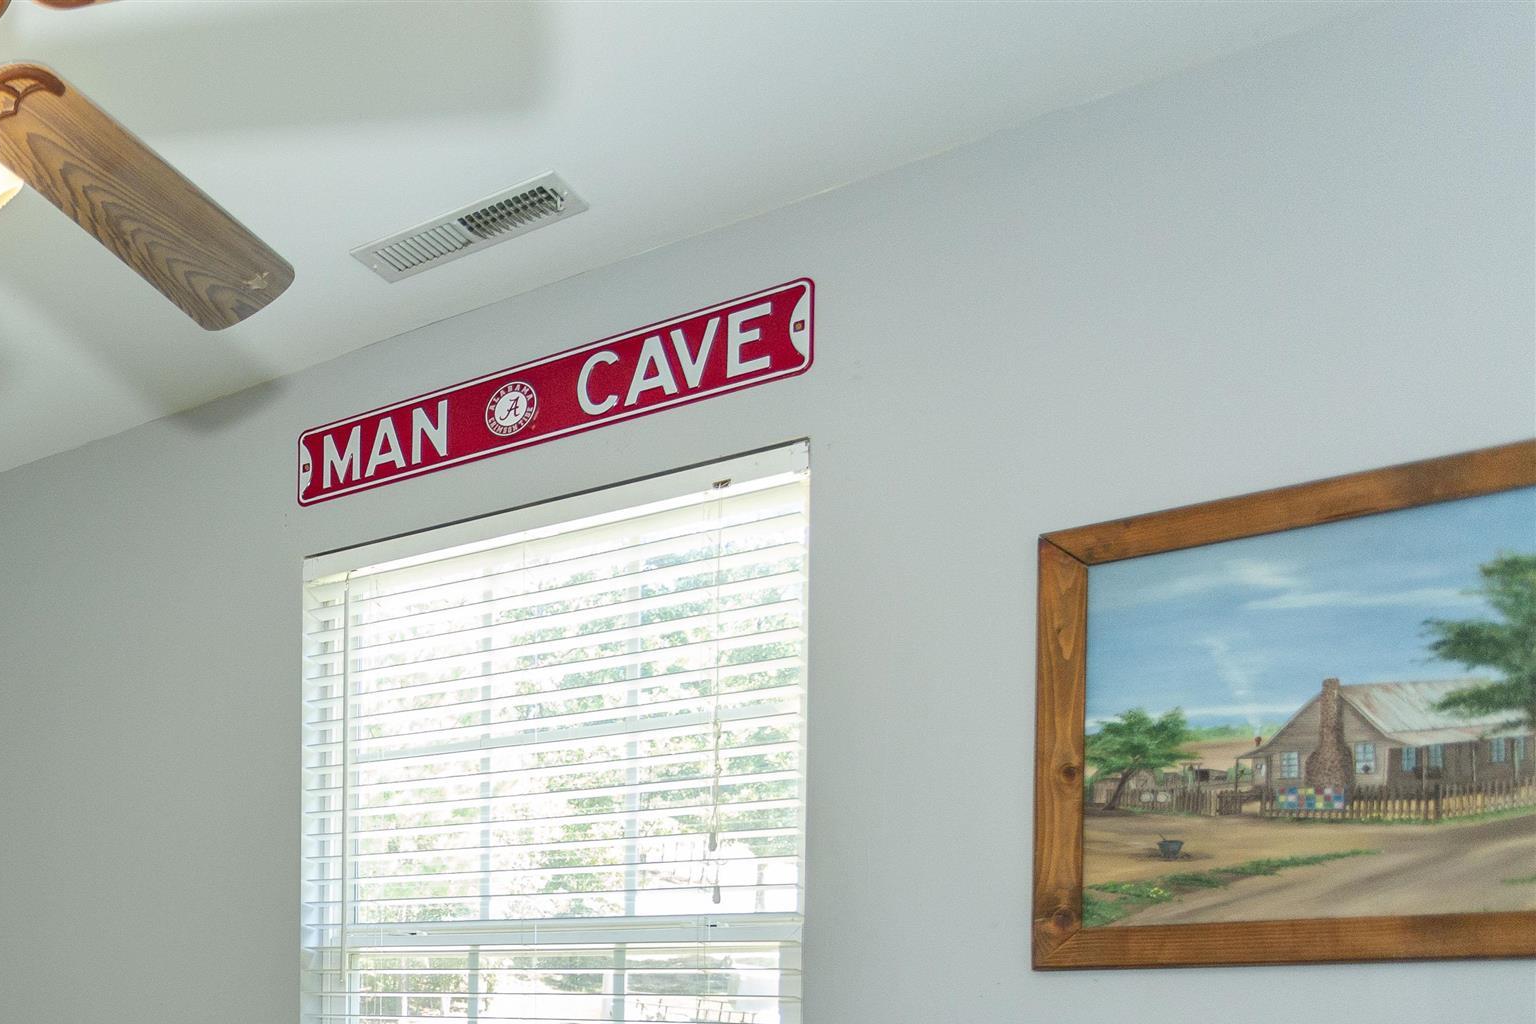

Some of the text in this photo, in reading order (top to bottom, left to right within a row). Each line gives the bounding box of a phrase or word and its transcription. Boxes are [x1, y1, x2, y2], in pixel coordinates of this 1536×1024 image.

[322, 301, 773, 489] MAN CAVE
[489, 384, 533, 411] ALABAMA
[499, 396, 520, 421] A
[488, 407, 534, 434] CRIMSON TIDE
